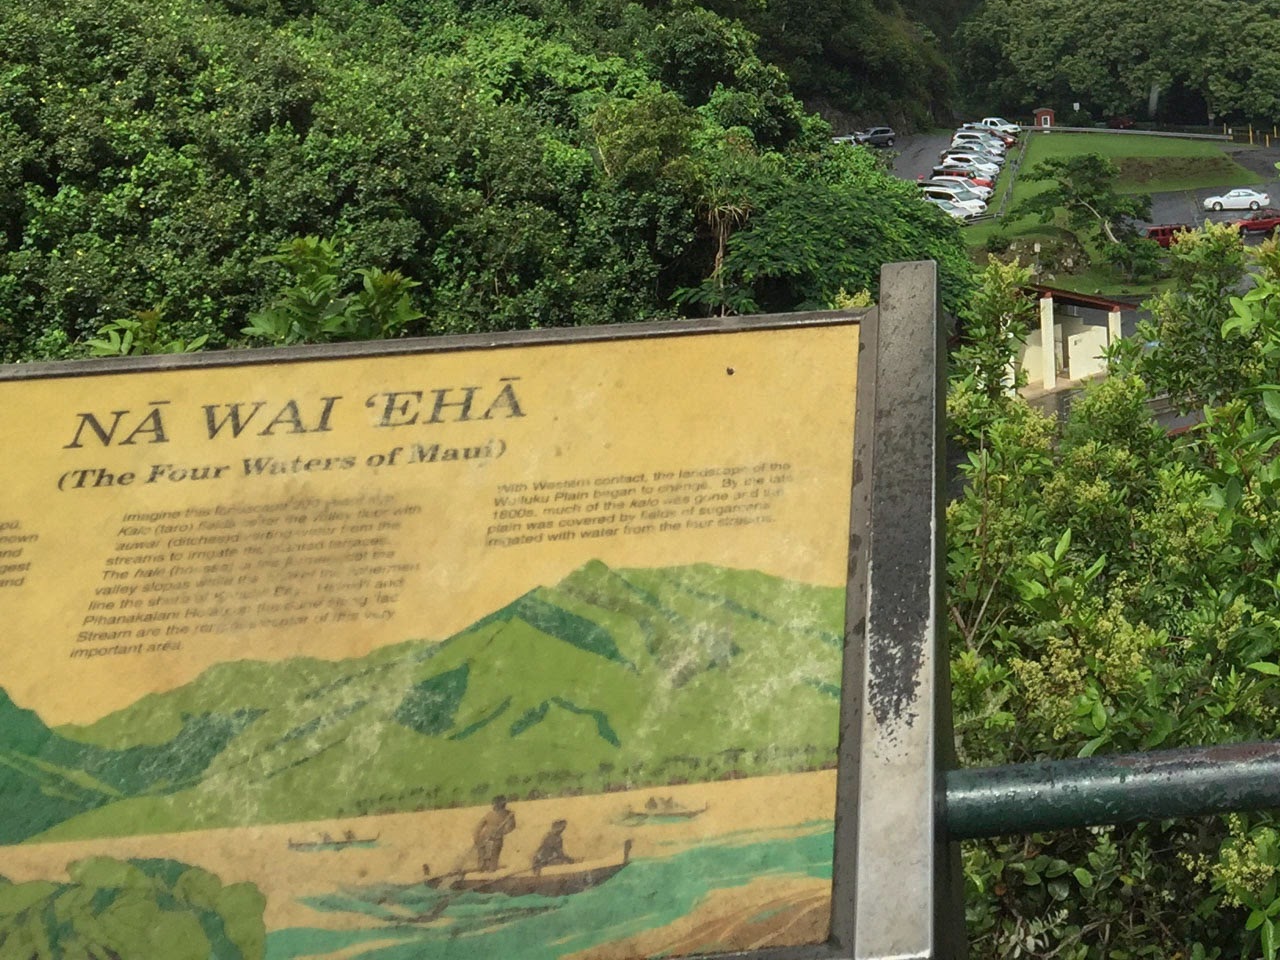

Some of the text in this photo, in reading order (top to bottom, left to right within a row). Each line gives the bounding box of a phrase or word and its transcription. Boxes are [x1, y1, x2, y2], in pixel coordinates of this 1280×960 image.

[63, 401, 170, 449] NĀ
[202, 391, 343, 440] WAI
[58, 440, 506, 491] (The Four Waters of Maui)
[554, 492, 588, 501] Plain
[543, 504, 581, 515] much
[586, 502, 599, 512] of
[604, 501, 625, 510] the
[527, 521, 553, 530] was
[559, 514, 616, 527] covered
[548, 530, 576, 541] with
[580, 528, 619, 538] water
[170, 552, 183, 561] to
[103, 570, 129, 580] The
[76, 630, 132, 642] Stream
[70, 643, 143, 659] important
